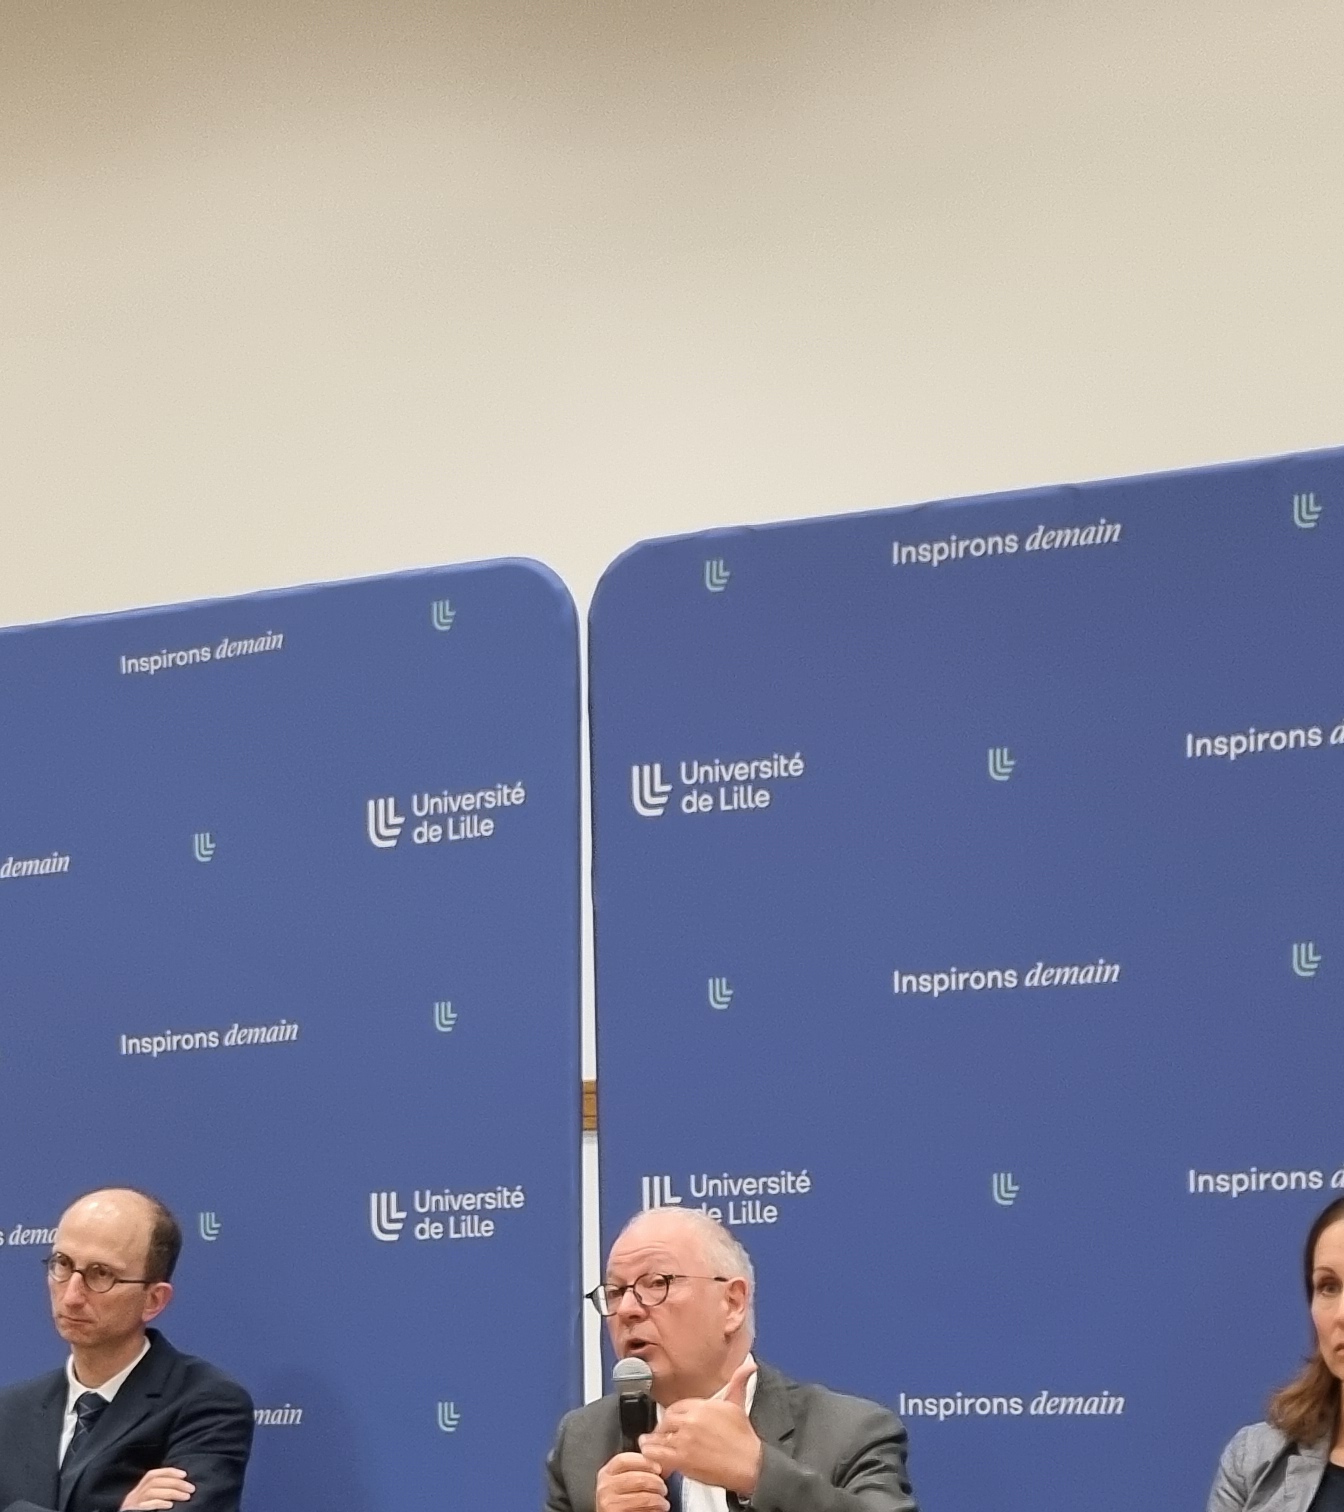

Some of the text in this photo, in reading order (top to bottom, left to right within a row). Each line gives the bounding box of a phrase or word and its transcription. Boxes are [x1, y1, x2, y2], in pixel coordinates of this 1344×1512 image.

[892, 518, 1122, 568] Inspirons demain
[119, 630, 284, 676] Inspirons demain
[1185, 725, 1323, 761] Inspirons
[680, 751, 805, 785] Université
[411, 780, 526, 817] Université
[680, 784, 771, 814] de Lille
[411, 813, 495, 845] de Lille
[893, 958, 1121, 998] Inspirons demain
[120, 1019, 299, 1058] Inspirons demain
[689, 1169, 812, 1198] Université
[1188, 1166, 1324, 1198] Inspirons
[413, 1184, 525, 1213] Université
[728, 1199, 779, 1225] Lille
[413, 1214, 495, 1241] de Lille
[898, 1390, 1126, 1421] Inspirons demain
